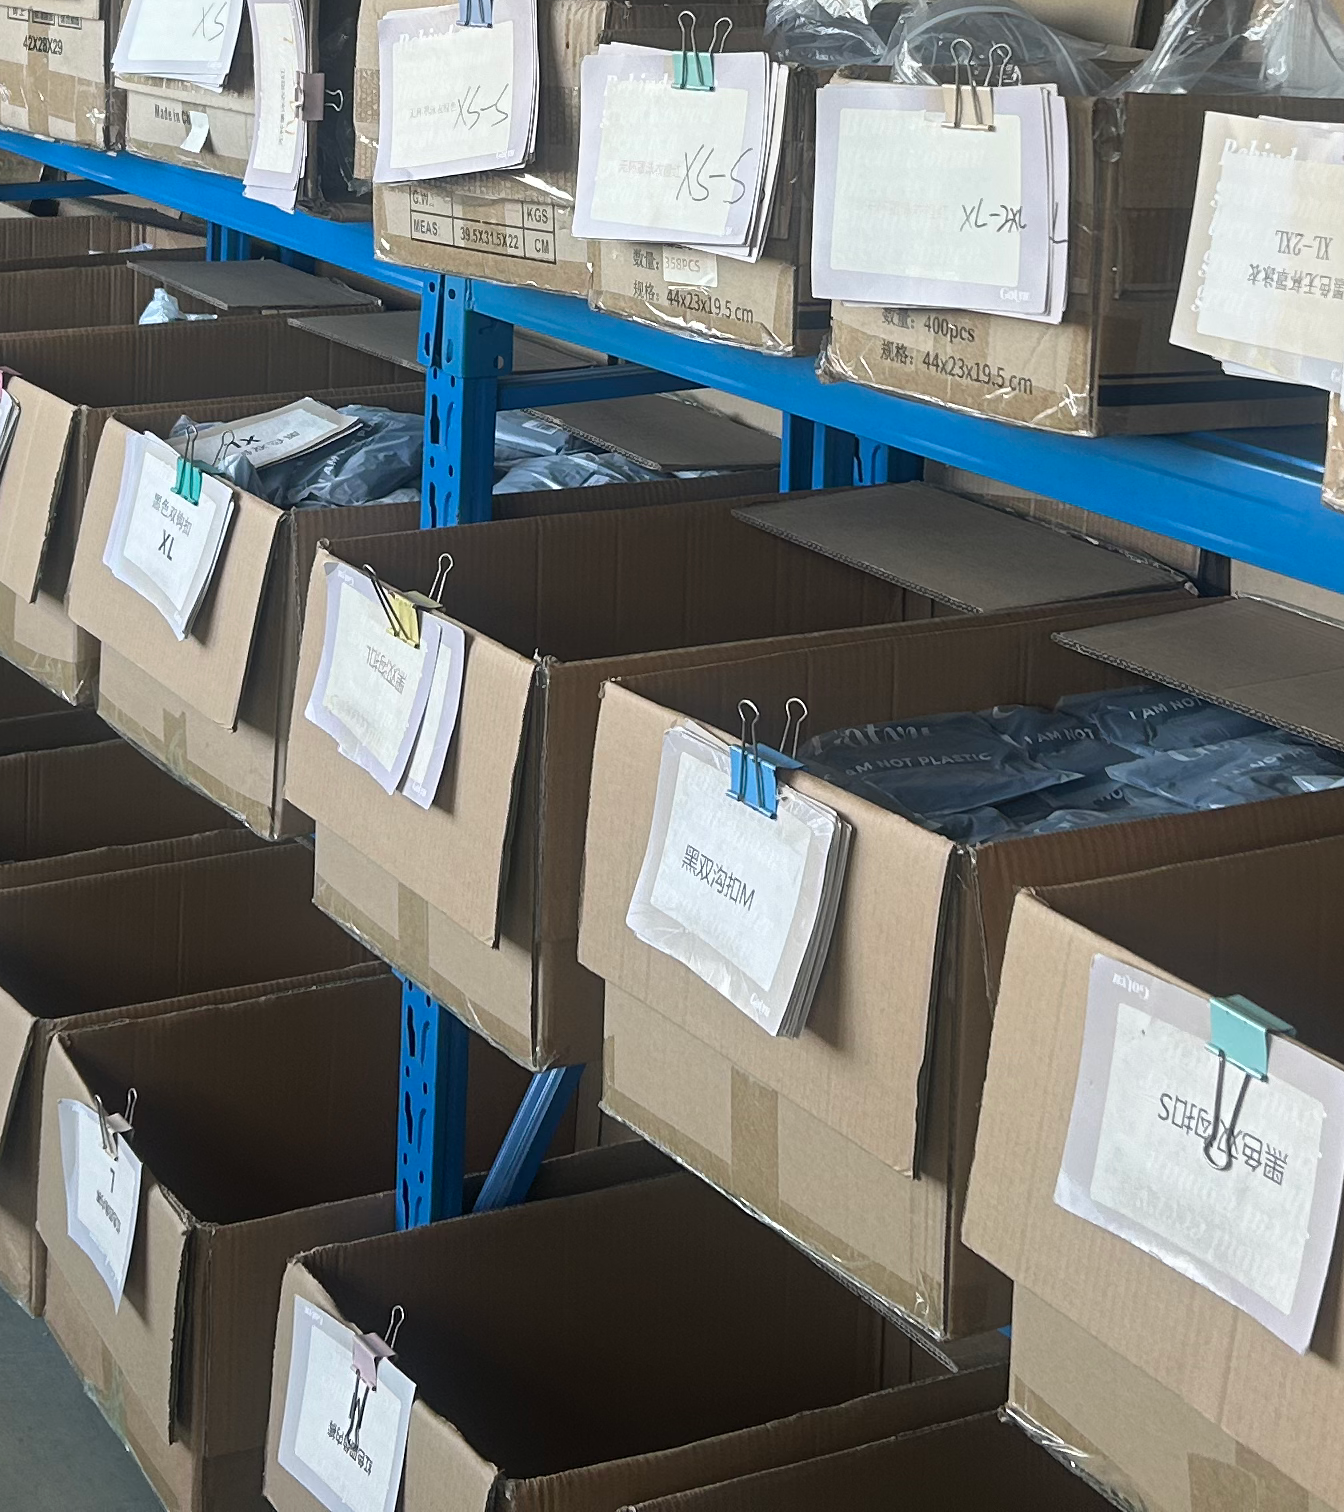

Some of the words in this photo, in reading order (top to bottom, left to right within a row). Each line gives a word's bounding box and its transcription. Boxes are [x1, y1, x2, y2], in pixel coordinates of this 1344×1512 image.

[192, 1, 228, 41] XS
[23, 34, 63, 56] 42X28X29
[454, 83, 509, 130] XS-S
[676, 144, 753, 204] XS-S
[527, 207, 548, 224] KGS
[960, 198, 1027, 233] XL-2XL
[460, 226, 519, 249] 39.5X31.5X22
[534, 238, 550, 254] CM
[1275, 230, 1333, 260] XL-2XL
[665, 256, 701, 273] 358PCS
[666, 289, 732, 320] 44x23x19.5
[734, 306, 754, 323] cm
[924, 315, 975, 344] 400pcs
[922, 350, 1006, 389] 44x23x19.5
[1008, 374, 1034, 395] cm
[158, 529, 173, 562] XL
[1143, 702, 1168, 720] AM
[1038, 730, 1062, 744] AM
[1063, 727, 1096, 741] NOT
[877, 755, 913, 769] NOT
[918, 752, 992, 767] PLASTIC
[681, 844, 756, 911] 黑双沟扣M
